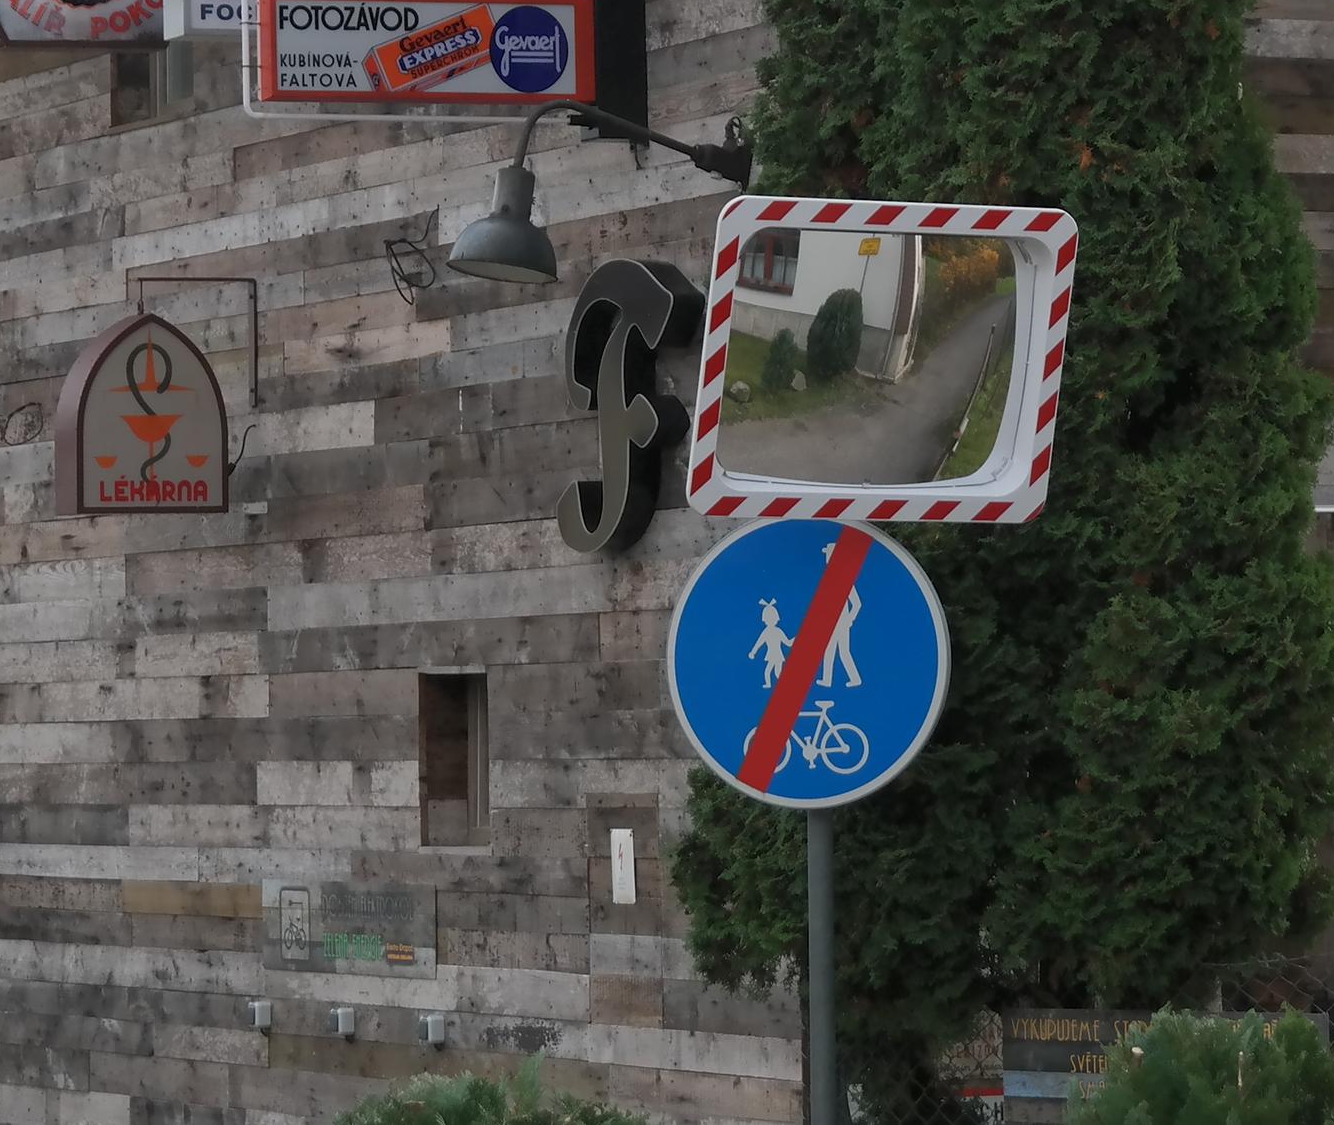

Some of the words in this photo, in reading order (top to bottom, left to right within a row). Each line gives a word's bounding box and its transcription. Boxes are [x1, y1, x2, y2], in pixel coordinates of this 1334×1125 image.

[278, 2, 419, 32] FOTOZÁVOD
[398, 15, 468, 53] Gevaert
[402, 30, 477, 70] EXPRESS
[410, 45, 480, 80] SUPERCHROM
[495, 25, 561, 77] Gevaert
[280, 71, 358, 89] FALTOVÁ
[99, 475, 209, 502] LÉKÁRNA
[1010, 1018, 1100, 1042] VYKUPUJEME
